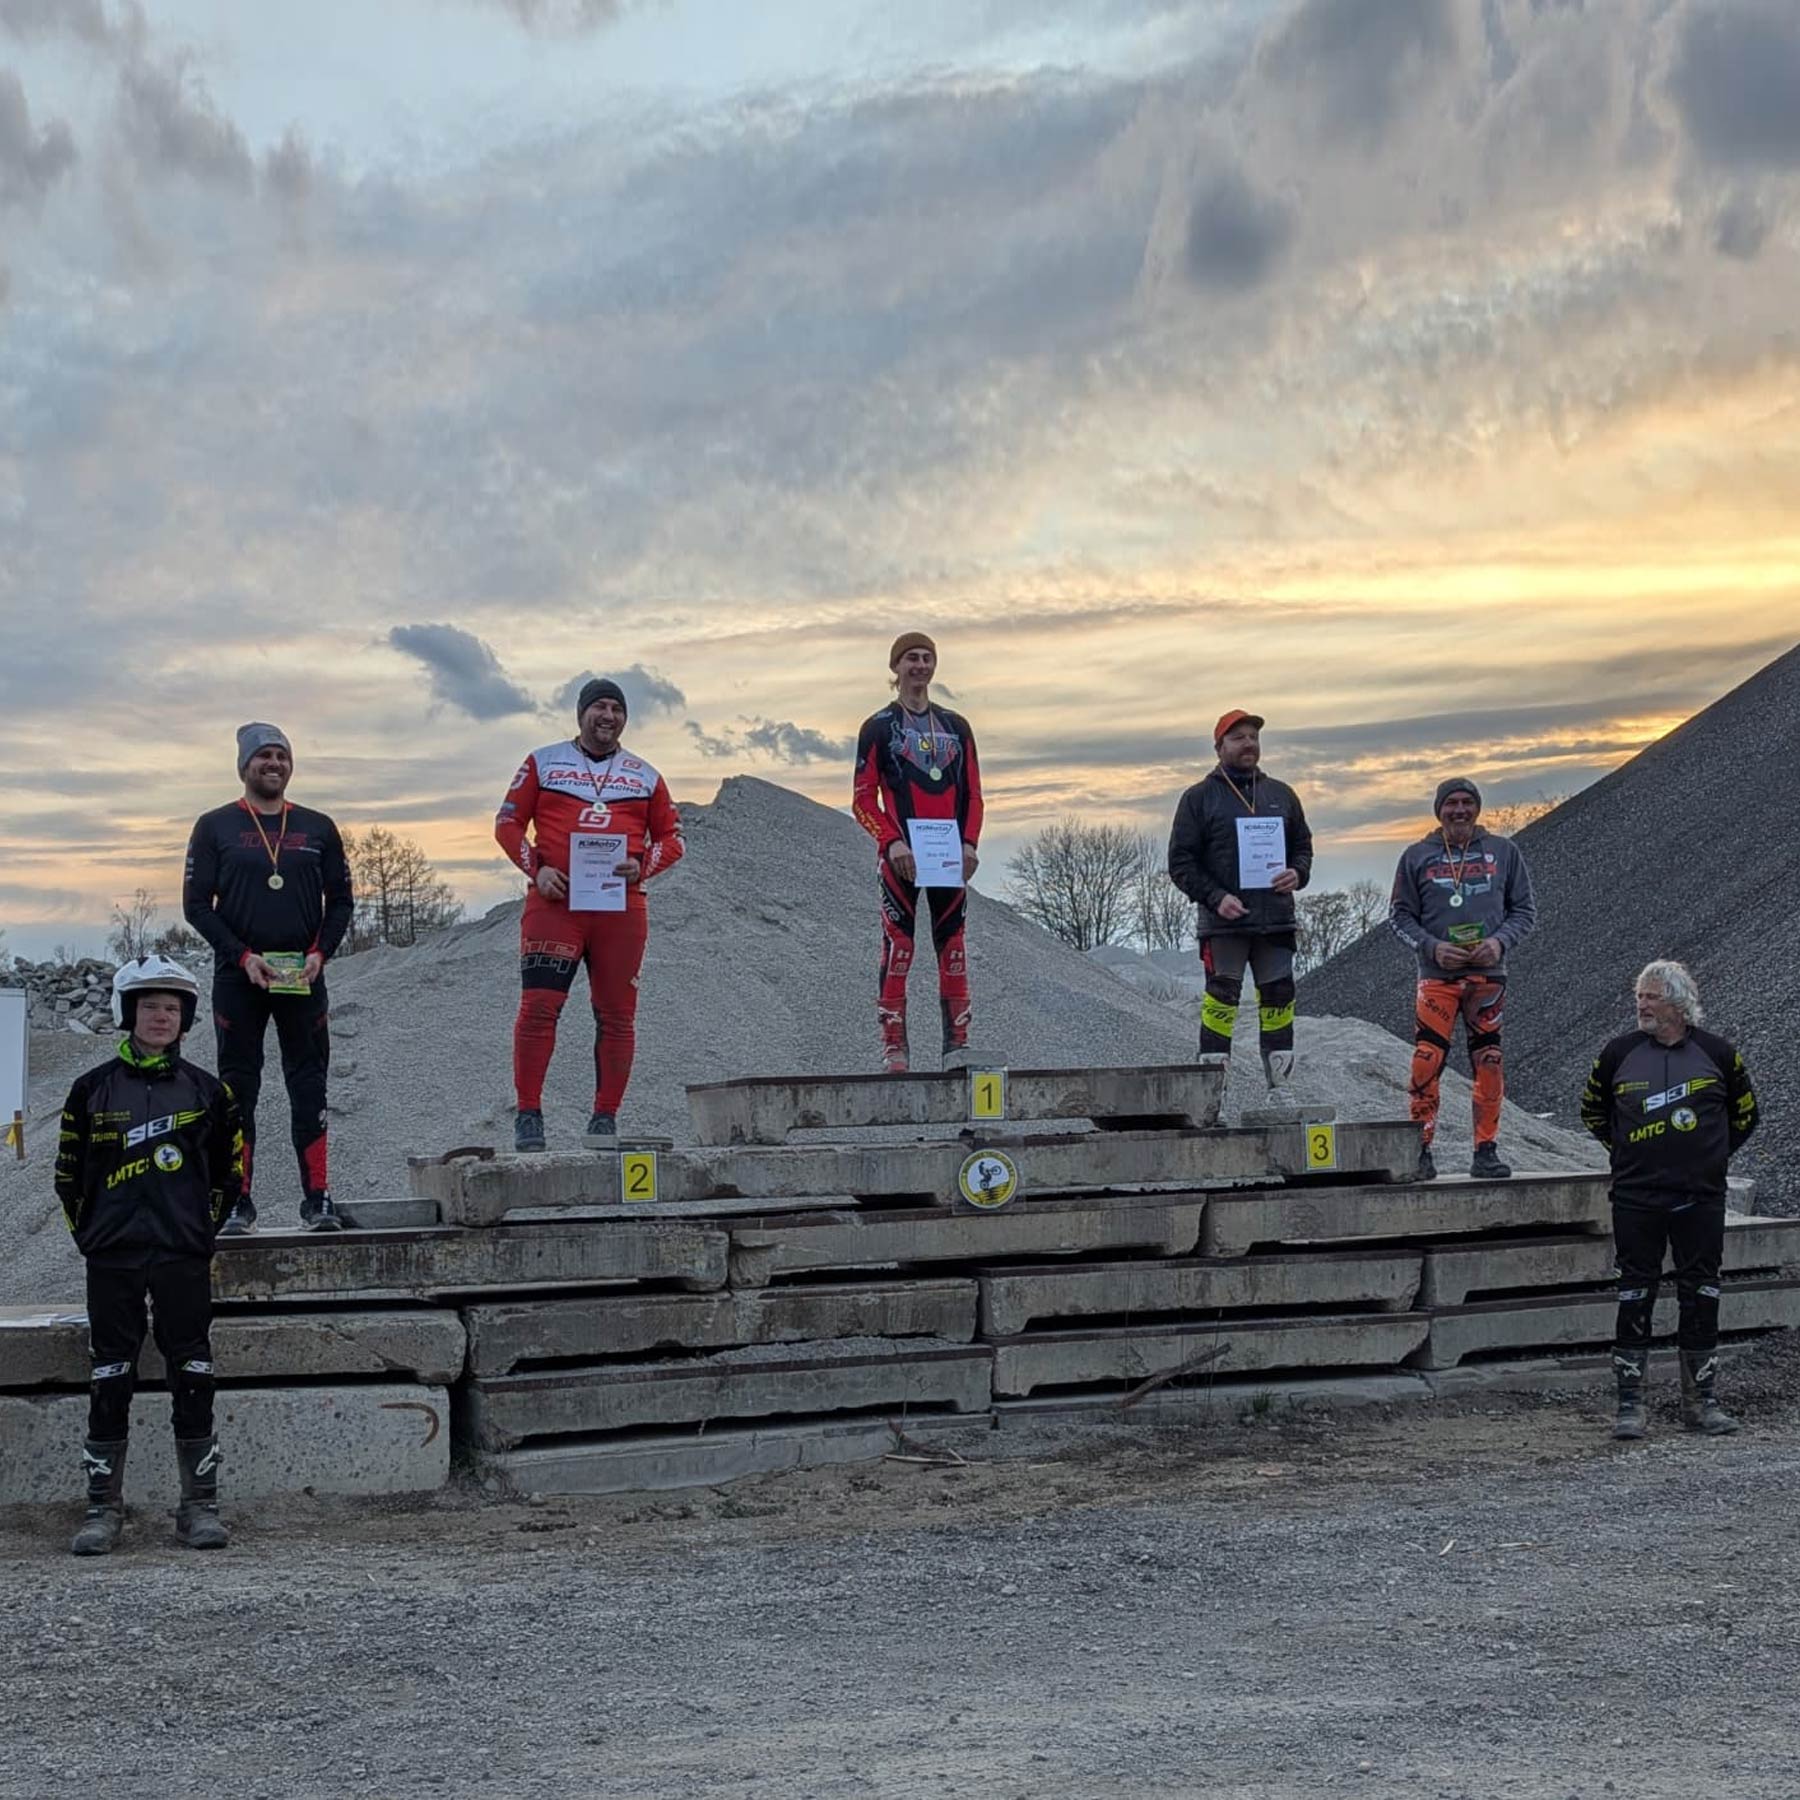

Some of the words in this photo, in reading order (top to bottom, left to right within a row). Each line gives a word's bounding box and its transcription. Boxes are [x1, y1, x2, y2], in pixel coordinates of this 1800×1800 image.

[547, 769, 643, 788] GASGAS
[981, 1081, 992, 1110] 1
[1645, 1083, 1687, 1113] S3
[127, 1114, 173, 1148] S3
[1313, 1134, 1329, 1160] 3
[630, 1163, 649, 1192] 2
